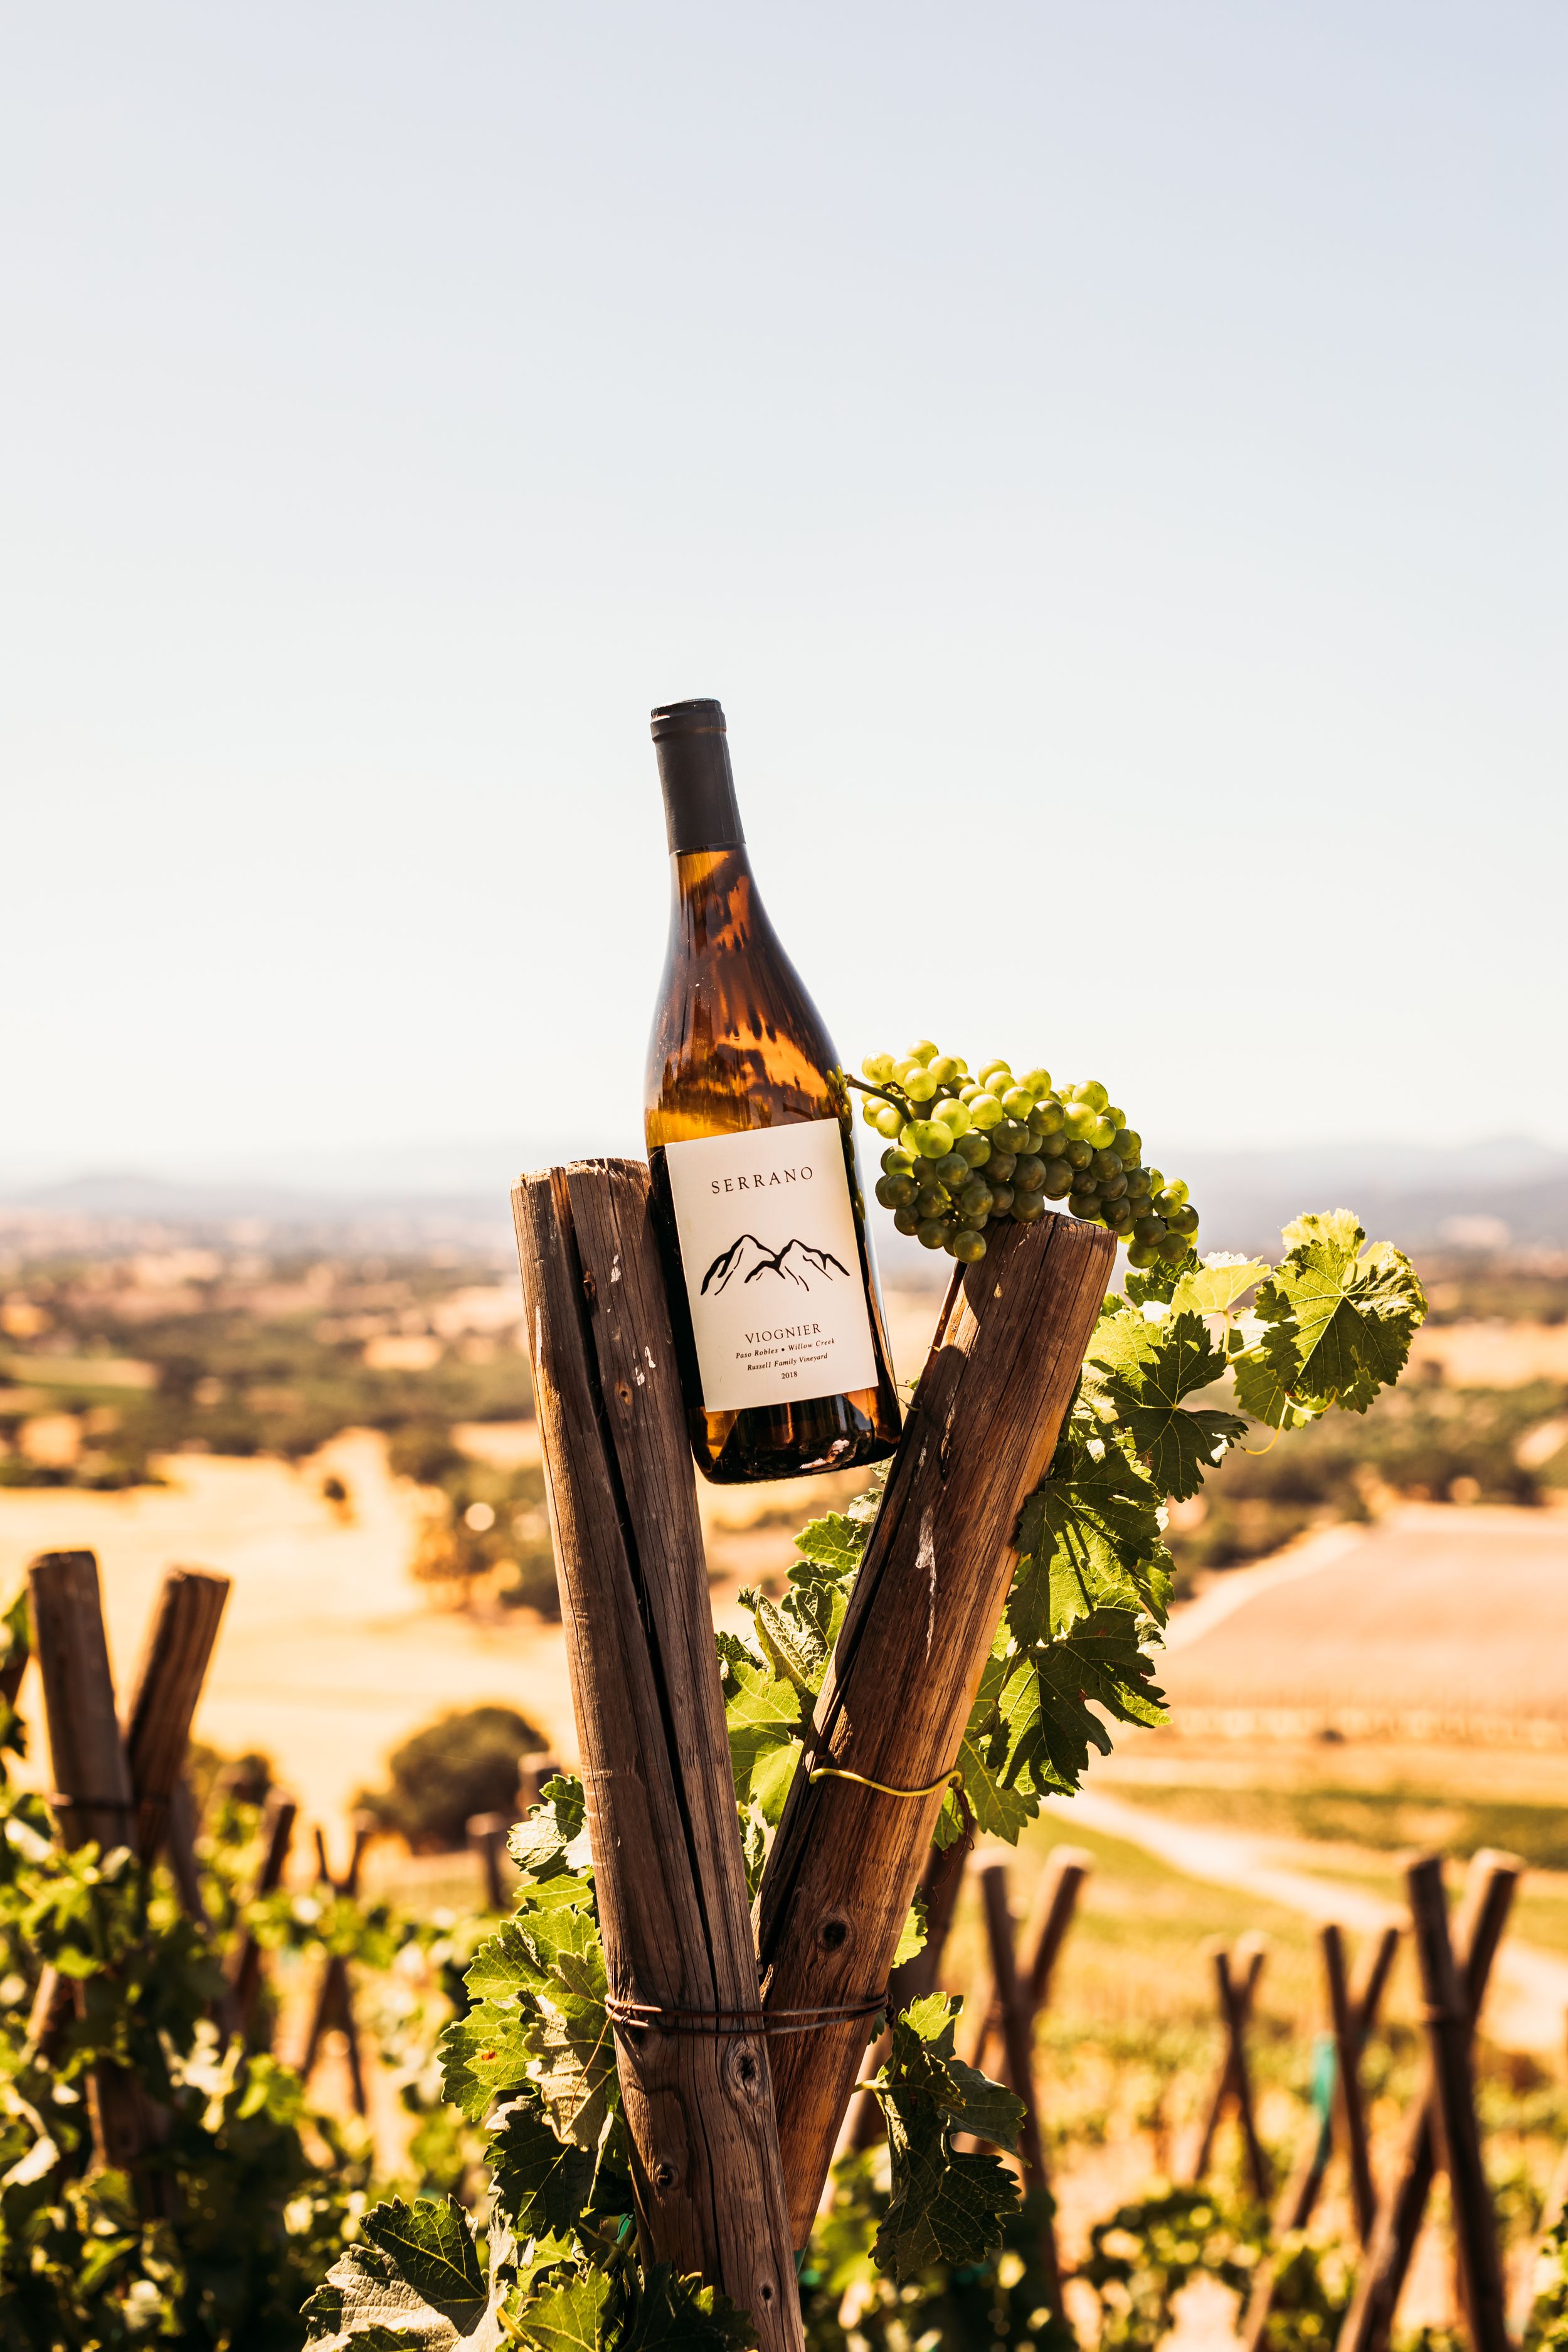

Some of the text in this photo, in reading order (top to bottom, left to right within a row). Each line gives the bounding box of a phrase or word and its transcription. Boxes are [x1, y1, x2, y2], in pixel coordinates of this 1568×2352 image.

[712, 1167, 812, 1194] SERRANO
[744, 1323, 821, 1343] VIOGNIER
[755, 1348, 778, 1356] Robles
[815, 1338, 835, 1347] Creek
[747, 1353, 828, 1370] Russell Family Vineyard
[781, 1371, 798, 1379] 2018
